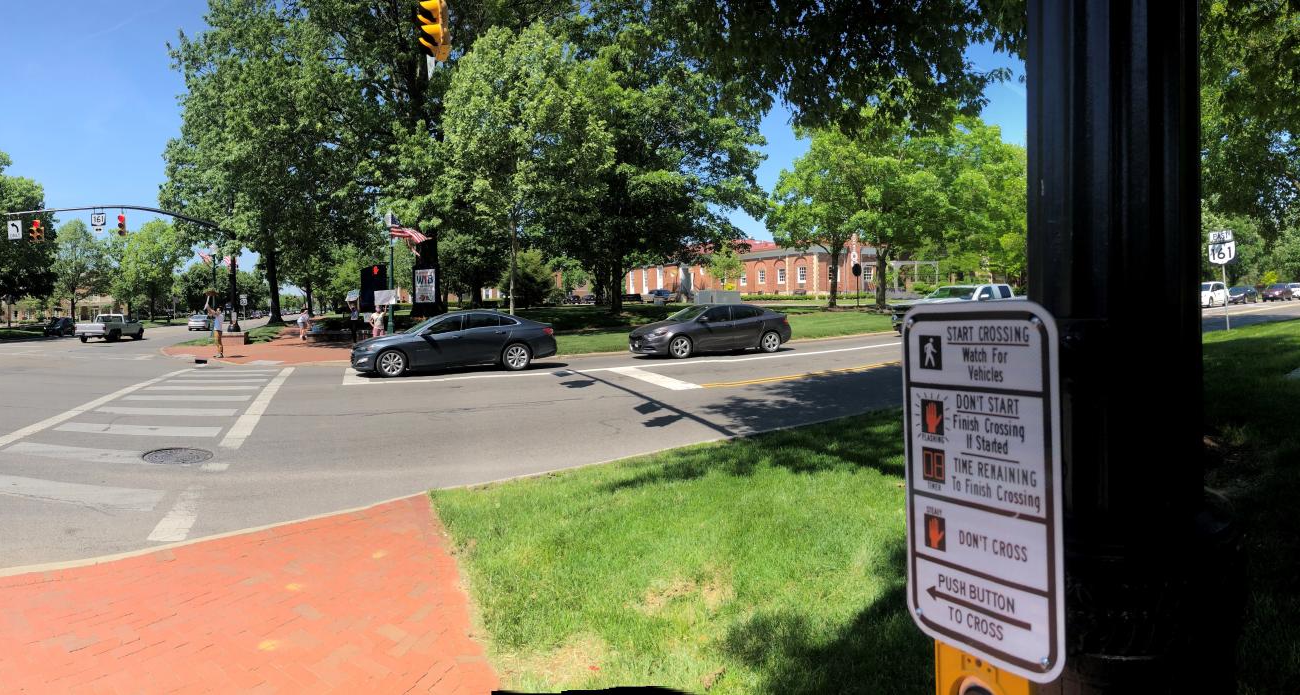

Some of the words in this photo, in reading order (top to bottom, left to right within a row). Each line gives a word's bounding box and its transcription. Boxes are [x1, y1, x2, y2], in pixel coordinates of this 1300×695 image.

[93, 215, 104, 224] 161
[1212, 231, 1228, 241] EAST
[1211, 246, 1232, 260] 161
[946, 326, 974, 342] START
[979, 325, 1030, 343] CROSSING
[962, 348, 988, 363] Watch
[992, 348, 1008, 364] For
[967, 365, 1004, 383] Vehicles
[956, 393, 984, 411] DON'T
[989, 397, 1020, 415] START
[922, 434, 946, 444] FLASHING
[953, 414, 980, 432] Finish
[984, 417, 1025, 443] Crossing
[966, 434, 973, 449] If
[976, 435, 1009, 455] Started
[953, 457, 973, 478] TIME
[978, 461, 1037, 488] REMAINING
[951, 476, 962, 492] To
[965, 479, 992, 498] Finish
[997, 484, 1041, 513] Crossing
[958, 530, 988, 552] DON'T
[992, 539, 1028, 563] CROSS
[938, 574, 966, 597] PUSH
[969, 583, 1016, 615] BUTTON
[948, 605, 963, 625] TO
[966, 613, 1004, 641] CROSS
